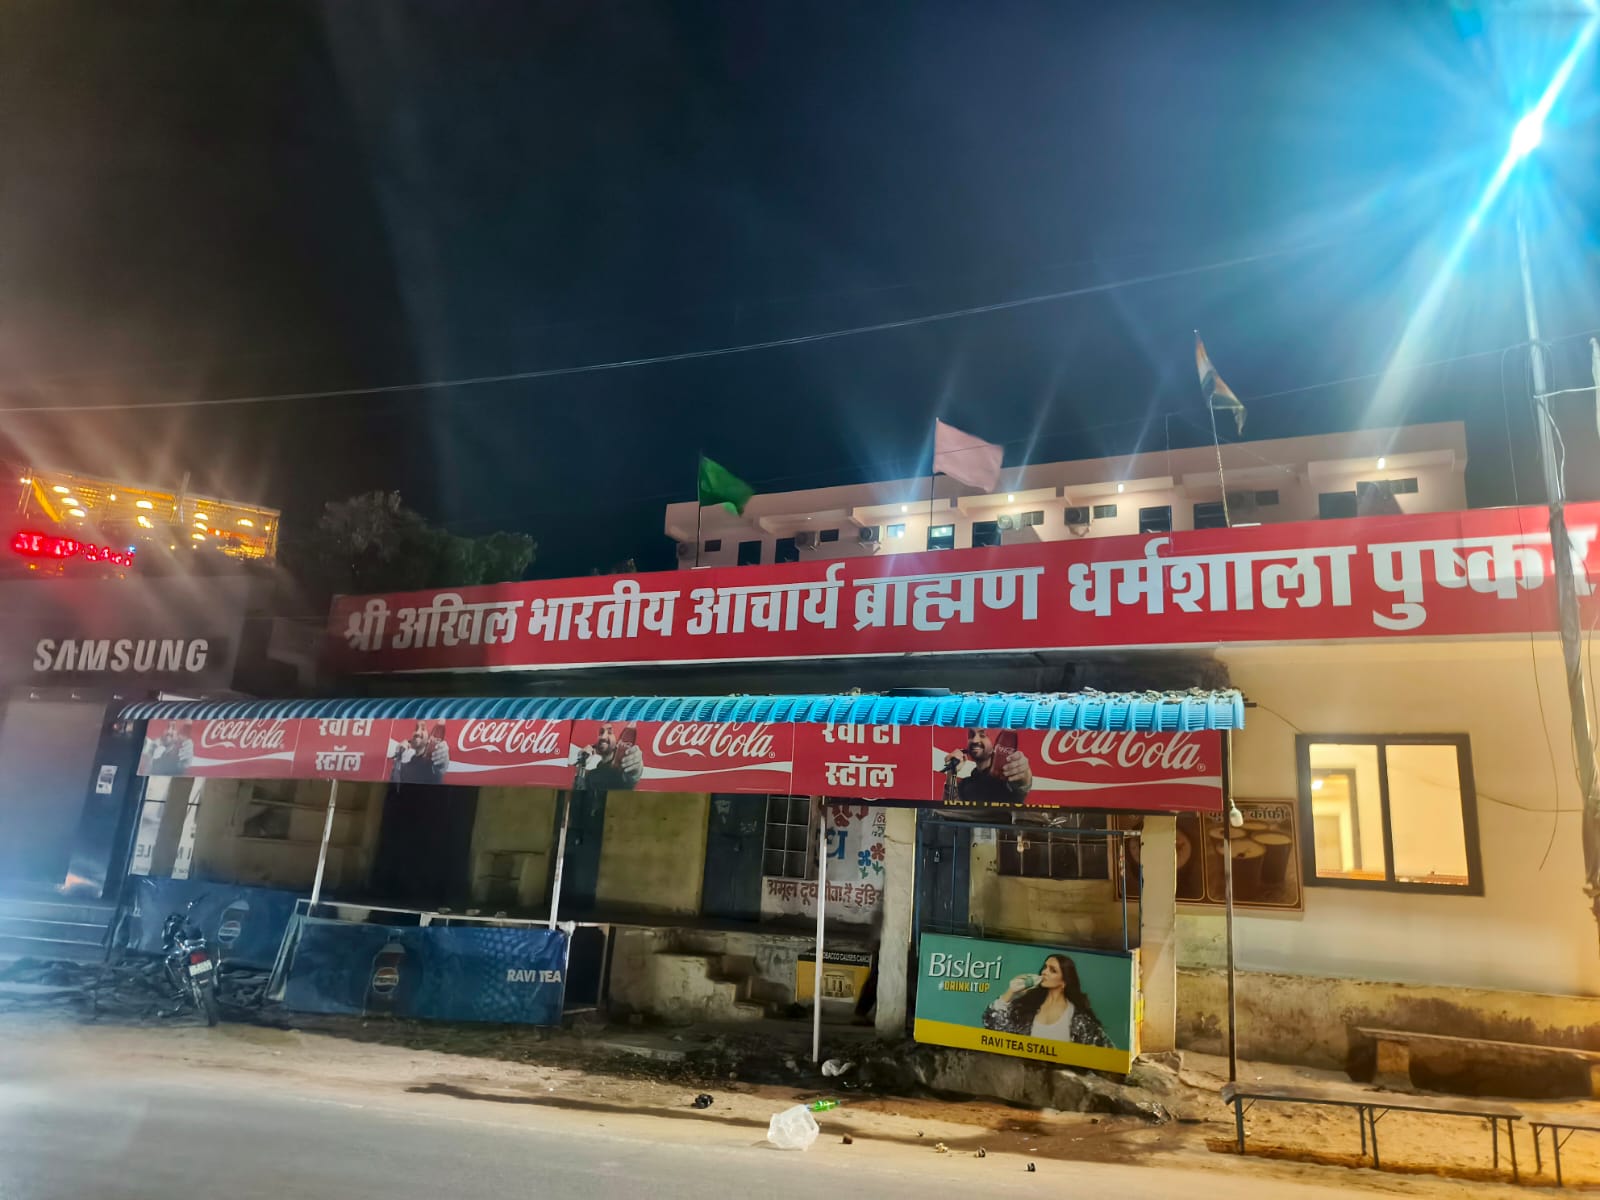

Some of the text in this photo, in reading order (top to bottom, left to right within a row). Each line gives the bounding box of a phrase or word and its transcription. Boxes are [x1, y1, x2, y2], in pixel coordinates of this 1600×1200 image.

[344, 599, 390, 651] श्री
[392, 593, 524, 649] अखिल
[528, 580, 681, 642] भारतीय
[686, 562, 846, 635] आचार्य
[852, 566, 1045, 631] ब्राह्मण
[1068, 537, 1357, 616] धर्मशाला
[33, 639, 209, 672] SAMSUNG
[824, 755, 898, 788] स्टॉल
[507, 969, 562, 983] RAVI TEA
[928, 952, 1002, 979] Bisleri
[981, 1035, 1058, 1057] RAVI TEA STALL
